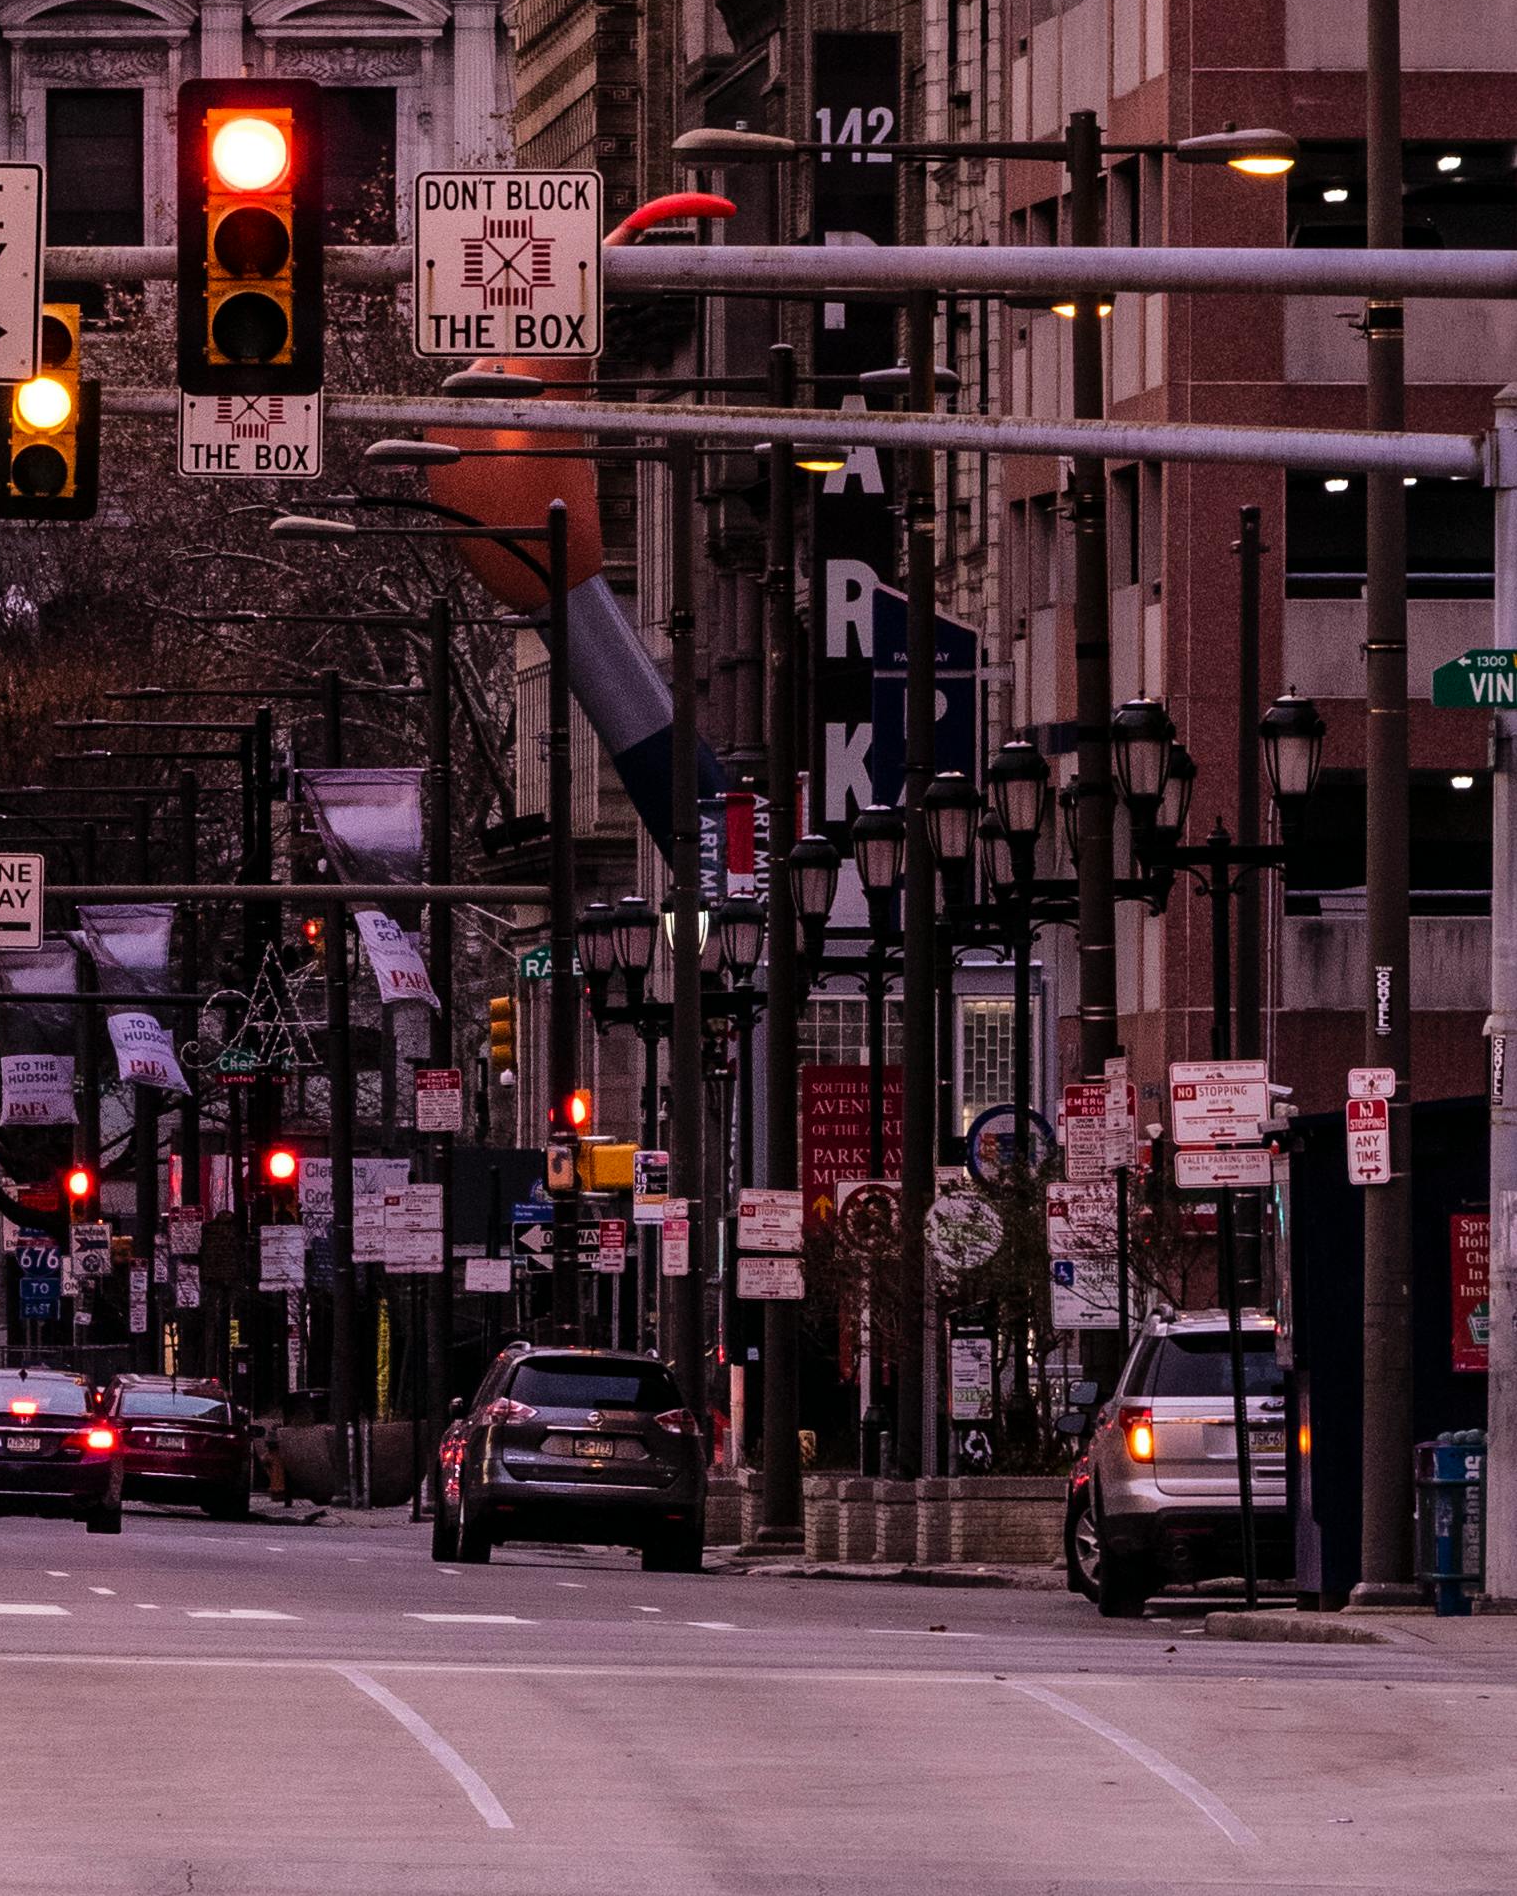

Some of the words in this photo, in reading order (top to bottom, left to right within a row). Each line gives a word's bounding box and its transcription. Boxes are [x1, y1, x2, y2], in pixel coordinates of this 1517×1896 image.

[425, 178, 496, 210] DON'T
[507, 180, 590, 210] BLOCK
[428, 314, 494, 348] THE
[515, 314, 587, 348] BOX
[190, 445, 239, 470] THE
[256, 445, 310, 471] BOX
[1477, 656, 1507, 667] 1300
[1469, 673, 1513, 703] VIN
[700, 815, 717, 860] ART
[527, 959, 583, 976] RAE
[123, 1031, 168, 1046] HUDSO
[34, 1060, 56, 1072] THE
[8, 1072, 58, 1083] HUDSON
[812, 1082, 863, 1094] SOUTH
[1177, 1086, 1193, 1099] NO
[1198, 1085, 1247, 1097] STOPPING
[9, 1102, 49, 1116] PAFA
[812, 1099, 893, 1115] AVENE
[1081, 1106, 1105, 1115] ROU
[1359, 1101, 1374, 1117] NO
[812, 1124, 830, 1136] OF
[834, 1124, 860, 1136] THE
[1349, 1117, 1385, 1130] STOPPING
[1355, 1135, 1380, 1148] ANY
[1182, 1155, 1205, 1164] VALET
[1208, 1154, 1243, 1164] PARKING
[1246, 1154, 1265, 1163] ONLY
[1356, 1150, 1381, 1163] TIME
[636, 1163, 642, 1172] 4
[636, 1183, 647, 1193] 27
[743, 1206, 755, 1216] NO
[758, 1209, 790, 1217] STOPPING
[1459, 1235, 1488, 1248] Holi
[20, 1248, 59, 1269] 676
[1468, 1268, 1483, 1280] In
[31, 1282, 49, 1294] TO
[1460, 1284, 1488, 1297] Inst
[25, 1303, 51, 1315] EAST
